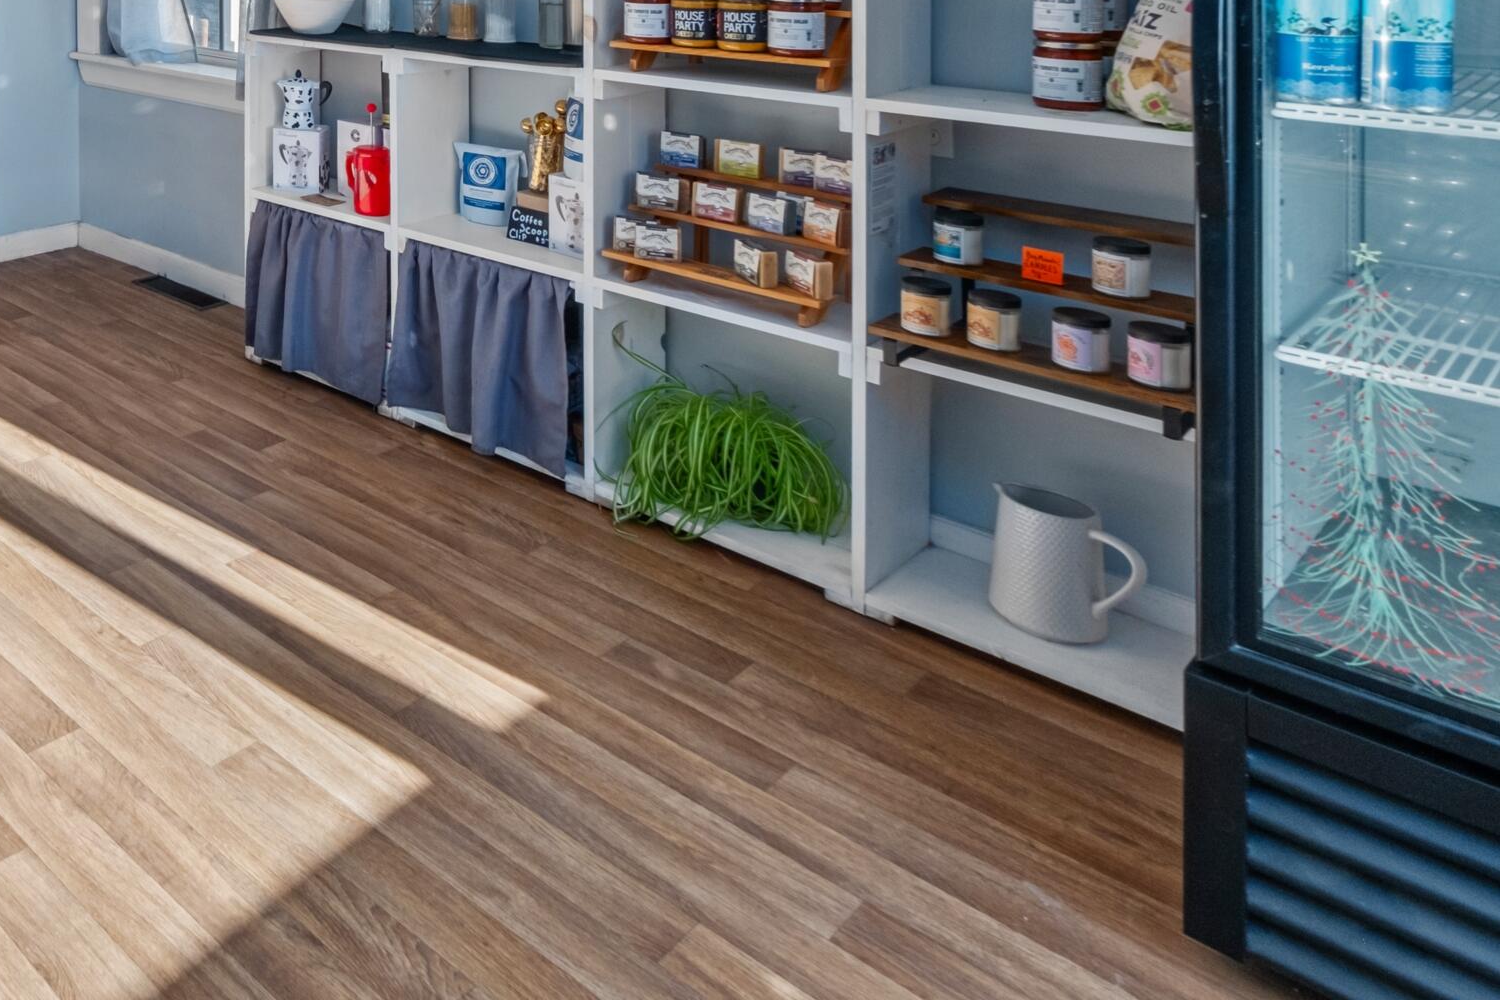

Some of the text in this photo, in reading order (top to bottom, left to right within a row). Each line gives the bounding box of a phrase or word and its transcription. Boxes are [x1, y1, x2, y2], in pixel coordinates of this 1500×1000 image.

[1157, 2, 1178, 14] OIL
[675, 10, 704, 22] HOUSE
[724, 12, 756, 23] HOUSE
[675, 20, 705, 31] PARTY
[724, 22, 756, 33] PARTY
[512, 208, 543, 226] Coffee
[509, 228, 527, 240] Clip
[520, 223, 548, 237] Scoop
